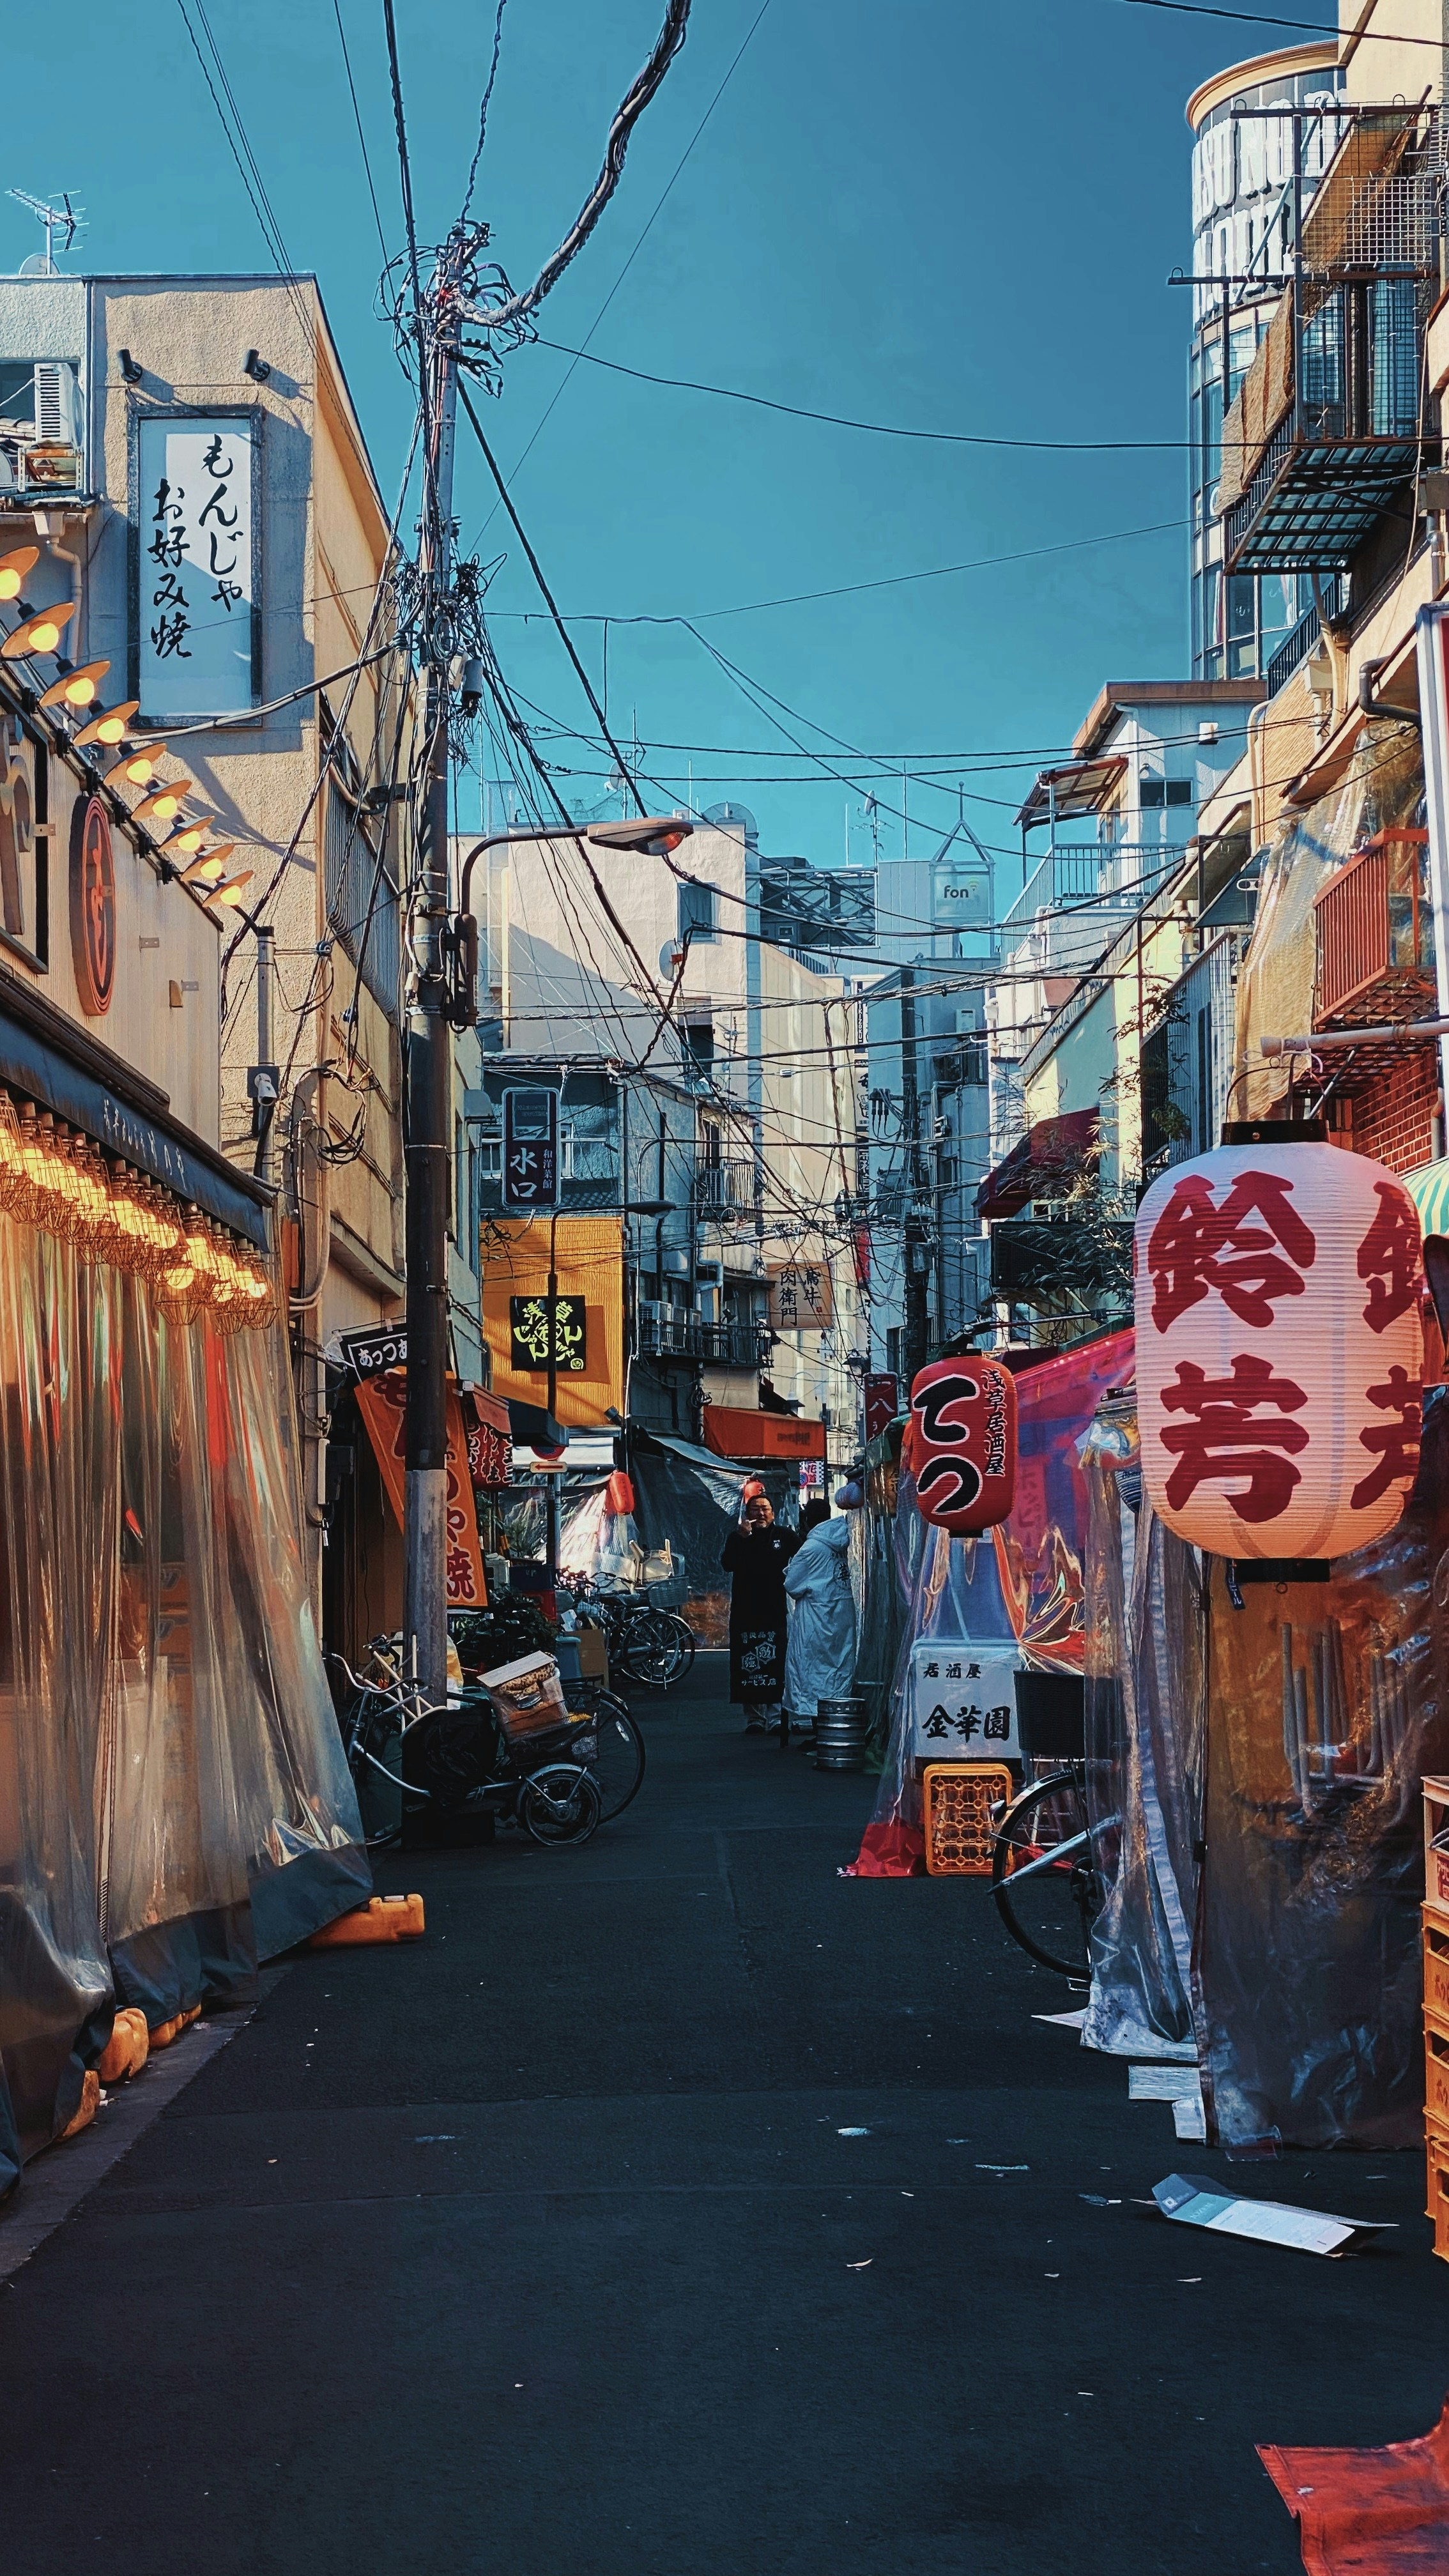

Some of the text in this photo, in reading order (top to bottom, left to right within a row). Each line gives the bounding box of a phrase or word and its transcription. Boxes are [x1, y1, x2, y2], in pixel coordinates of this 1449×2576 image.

[198, 434, 243, 612] もんじゃ
[147, 478, 193, 659] お好み焼
[944, 885, 969, 898] fon
[510, 1147, 538, 1198] 水口
[778, 1267, 798, 1327] 肉衛門
[1147, 1170, 1317, 1523] 鈴芳
[912, 1374, 983, 1515] てつ
[980, 1367, 1008, 1477] 浅草居酒屋
[923, 1662, 982, 1680] 居酒屋
[921, 1704, 1011, 1743] 金華園
